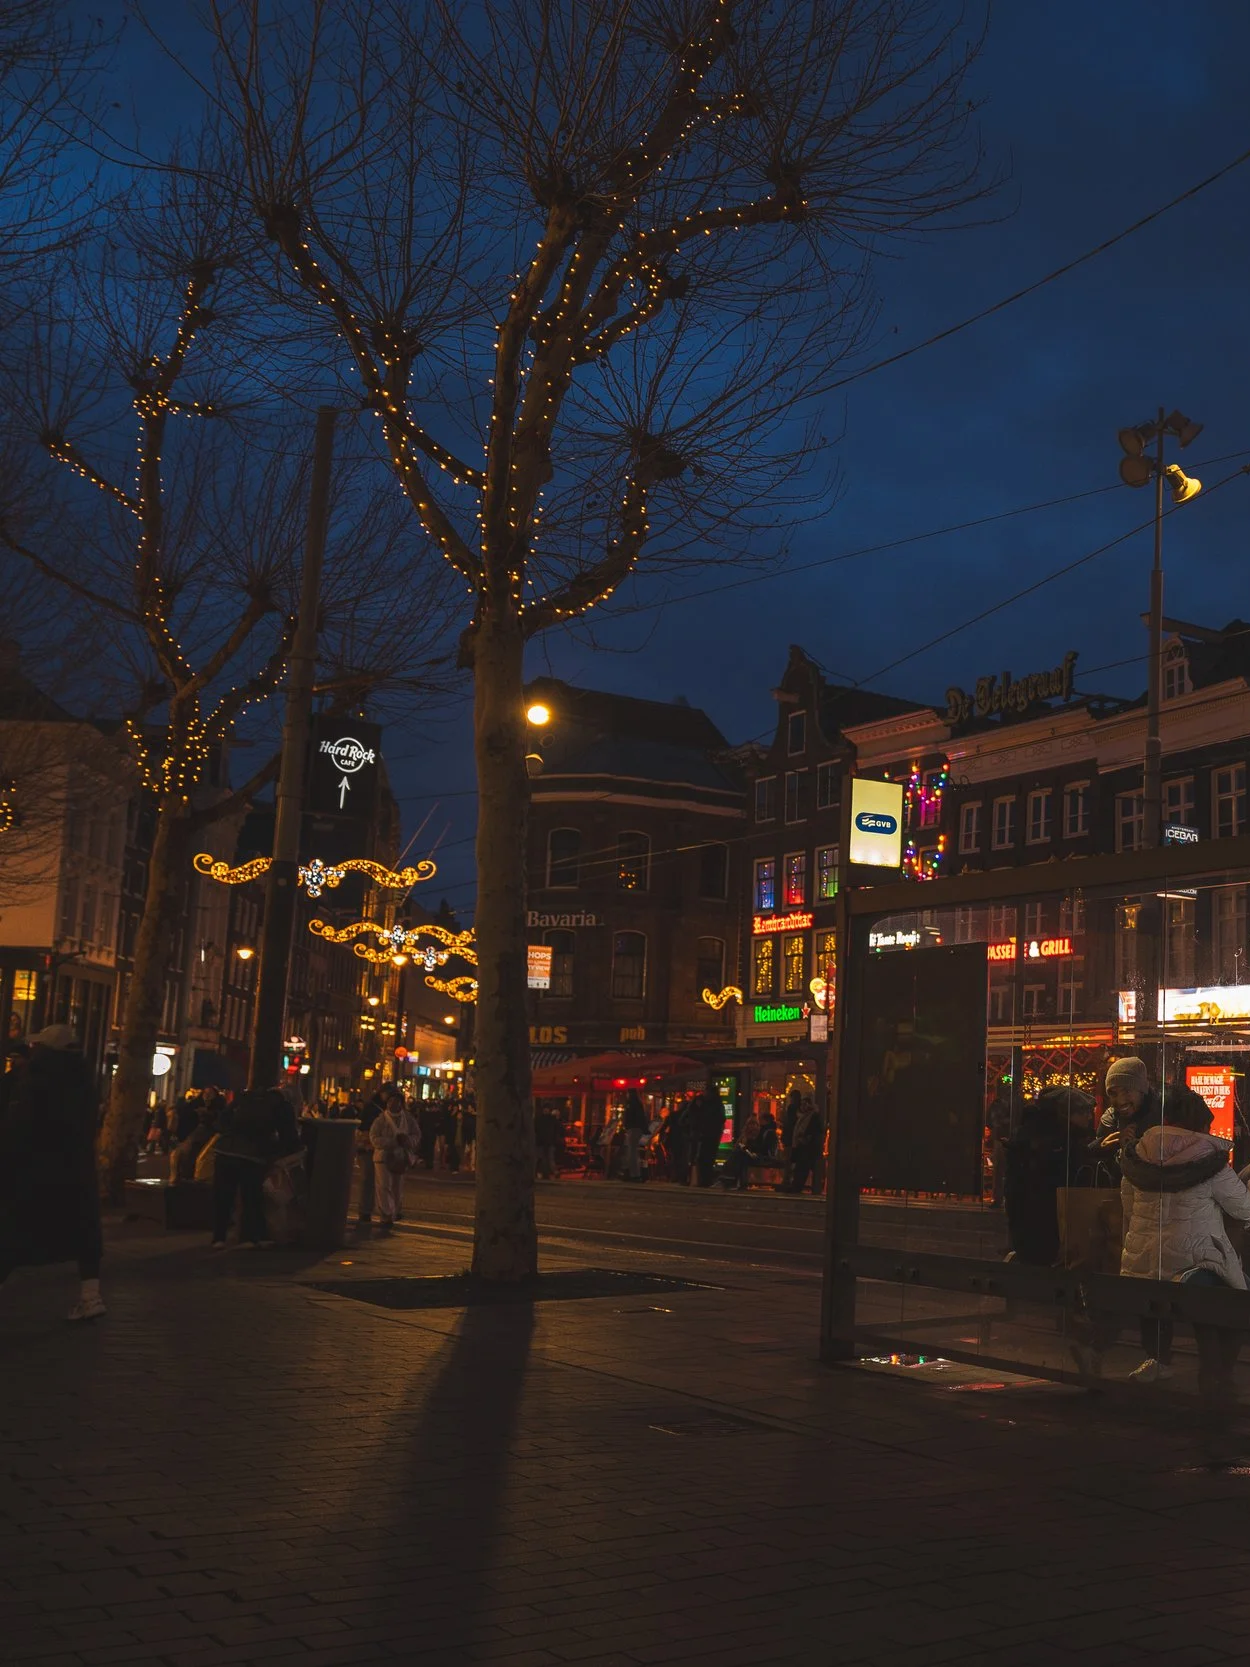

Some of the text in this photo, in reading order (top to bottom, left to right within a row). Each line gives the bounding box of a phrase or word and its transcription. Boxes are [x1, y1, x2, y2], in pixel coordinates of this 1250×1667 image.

[319, 740, 376, 764] Hard Rock
[1165, 829, 1199, 842] ICEBAR
[527, 910, 596, 927] Bavaria
[1028, 941, 1040, 957] &
[1040, 938, 1070, 956] GRILL
[754, 1004, 801, 1022] Heineken
